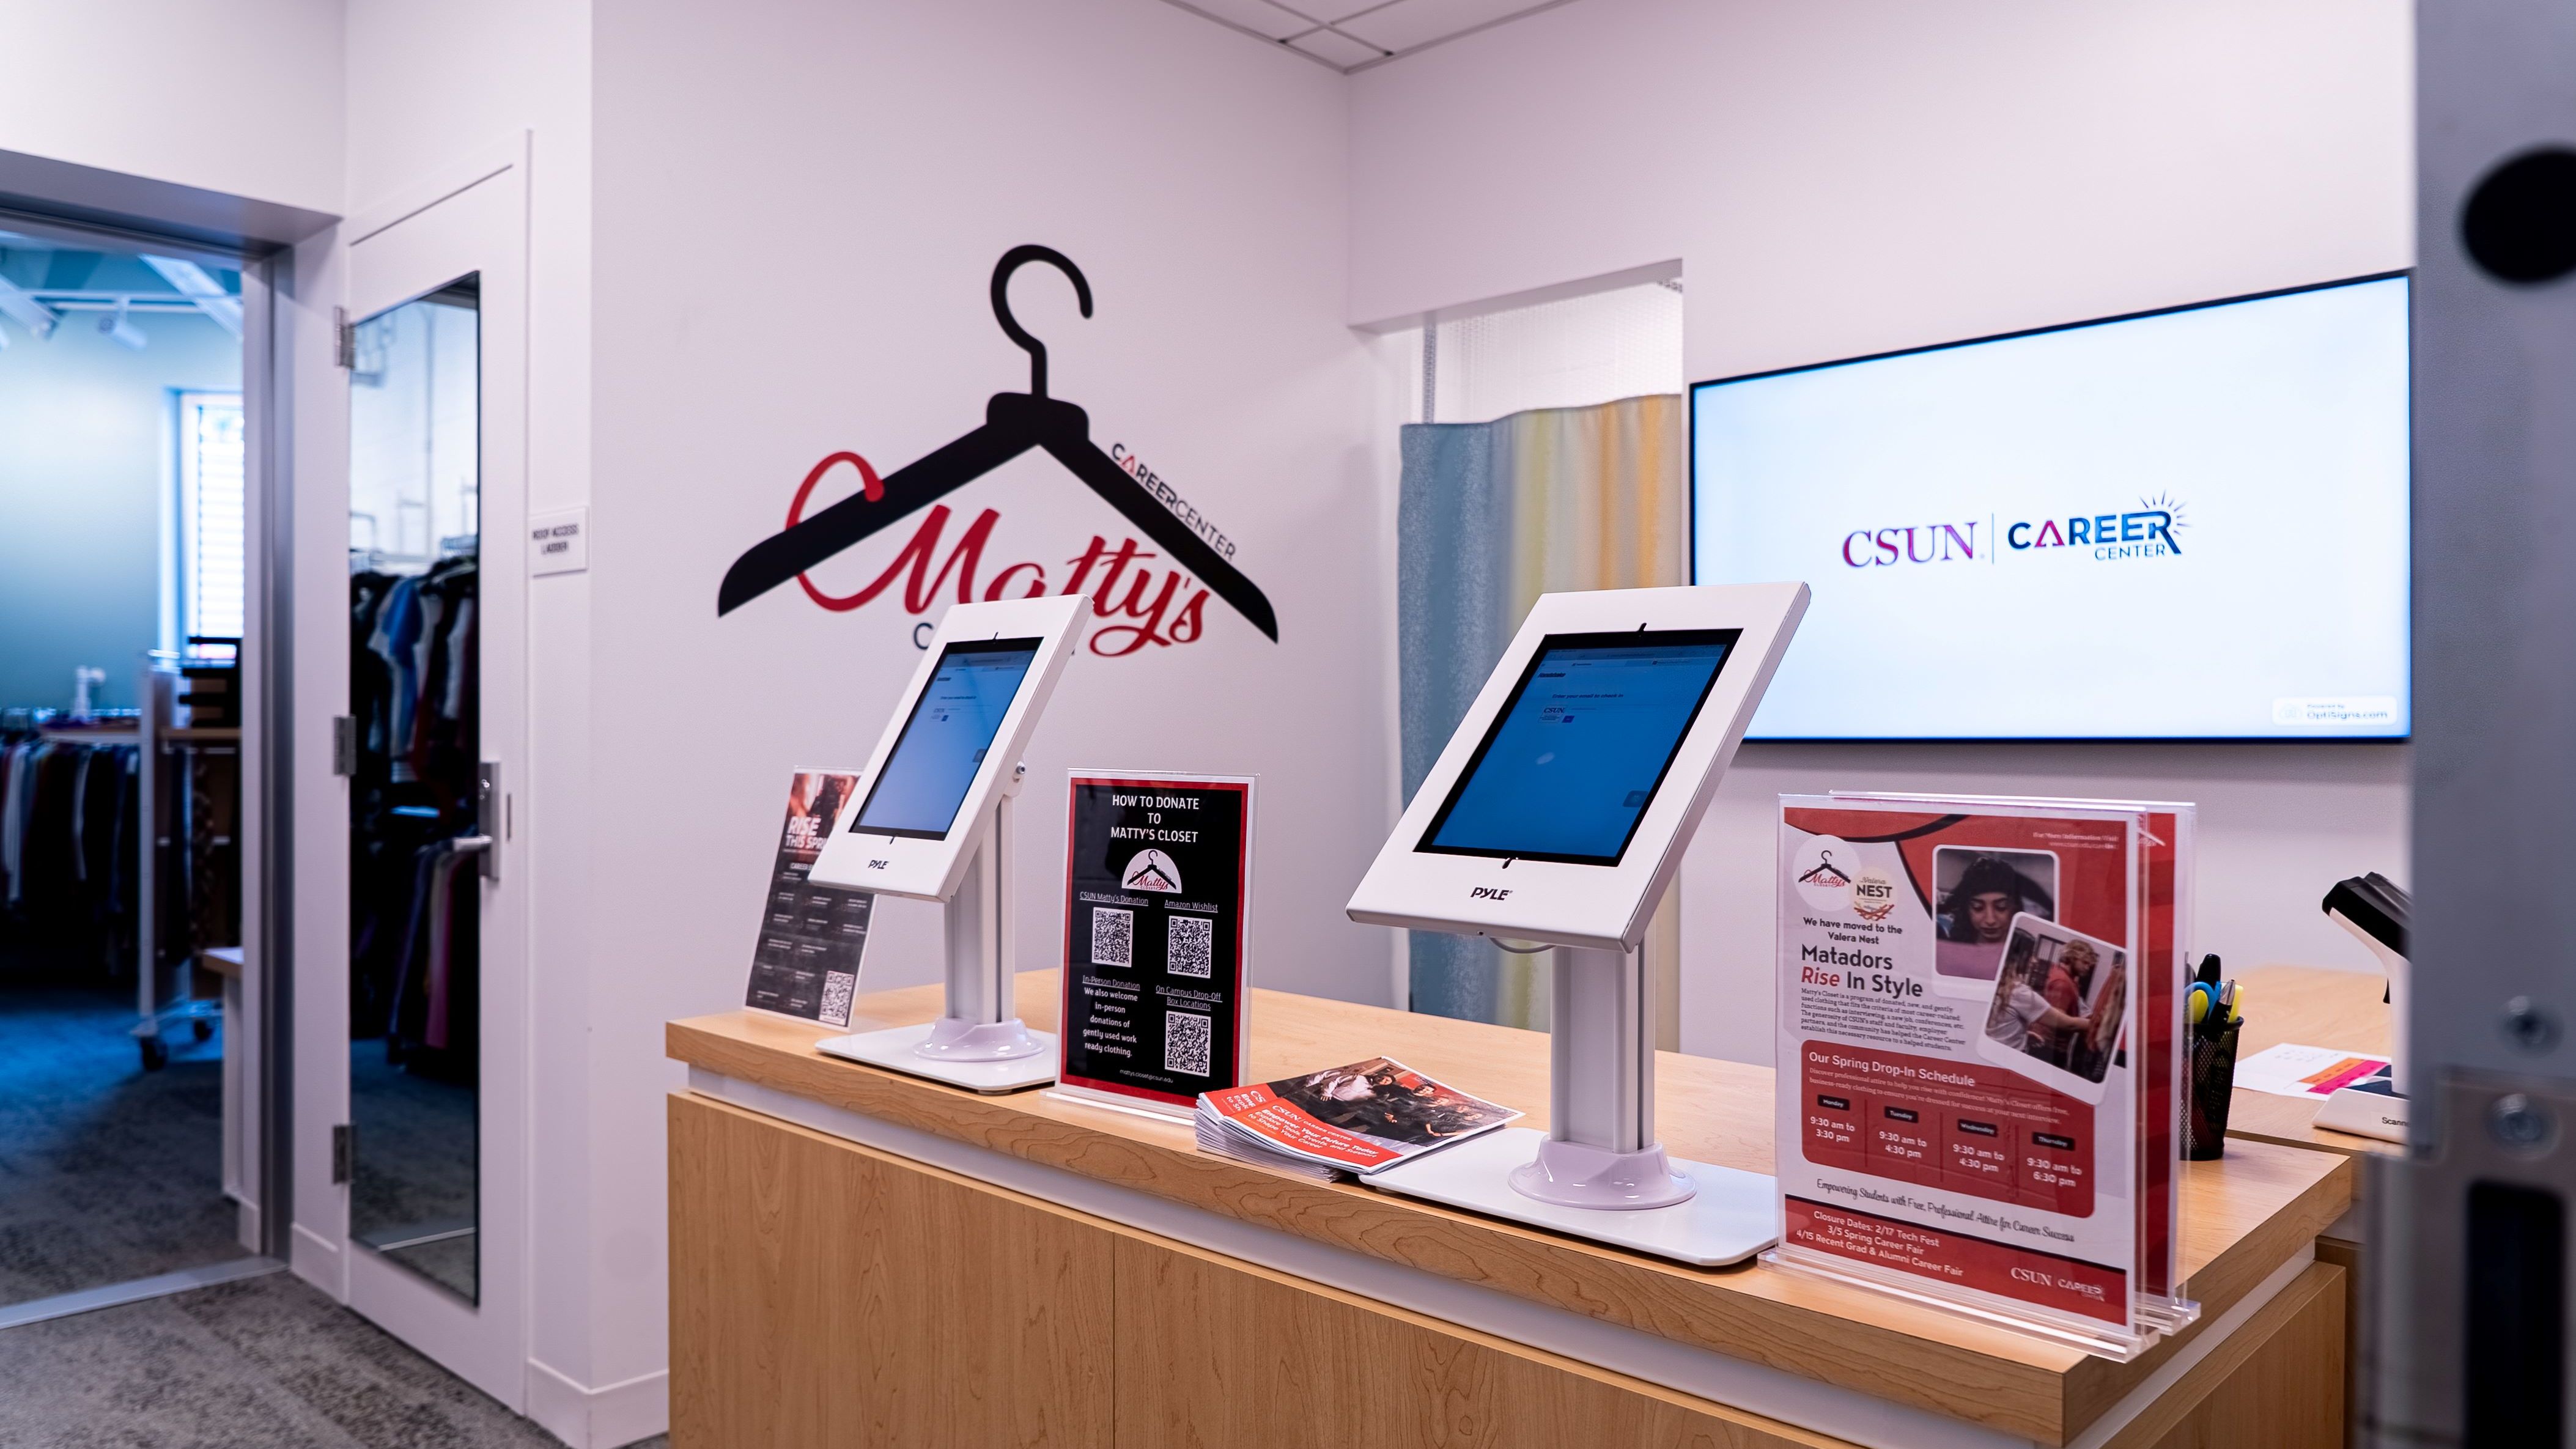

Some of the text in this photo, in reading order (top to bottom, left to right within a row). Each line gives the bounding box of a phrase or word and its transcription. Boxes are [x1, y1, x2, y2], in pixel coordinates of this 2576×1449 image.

[1842, 510, 2181, 569] CSUN CAREER
[785, 451, 1210, 658] Matty's
[2095, 544, 2165, 561] CENTER
[1112, 795, 1199, 809] HOW TO DONATE
[787, 816, 821, 836] RISE
[1147, 813, 1161, 824] TO
[786, 835, 805, 847] THIS
[1111, 827, 1198, 842] MATTY'S CLOSET
[868, 860, 888, 870] PYLE
[1470, 887, 1509, 901] PYLE
[1857, 884, 1892, 898] NEST
[1098, 893, 1119, 903] Matty's
[1121, 895, 1148, 905] Donation
[1164, 899, 1218, 912] Amazon Wishlist
[1803, 917, 1817, 926] We
[1820, 918, 1840, 927] have
[1887, 925, 1902, 934] the
[1828, 932, 1878, 944] Valera Nest
[1802, 945, 1892, 969] Matadors
[1082, 975, 1140, 989] In-Person Donation
[1801, 967, 1922, 998] Rise In Style
[1109, 991, 1137, 1001] welcome
[1165, 986, 1192, 998] Campus
[1194, 990, 1221, 1001] Drop-Off
[1095, 1001, 1125, 1012] in-person
[1179, 998, 1211, 1009] Locations
[1090, 1015, 1121, 1026] donations
[1083, 1029, 1103, 1039] gently
[1085, 1042, 1132, 1057] ready clothing.
[1809, 1052, 1975, 1086] Our Spring Drop-In Schedule
[1272, 1105, 1302, 1121] CSUN
[1810, 1116, 1829, 1126] 9:30
[1846, 1123, 1854, 1131] to
[2382, 1116, 2409, 1127] Scann
[1255, 1111, 1281, 1125] Explore
[1346, 1148, 1377, 1158] Support
[1257, 1118, 1279, 1130] Shape
[1281, 1129, 1297, 1139] Your
[1297, 1138, 1323, 1149] Career
[1261, 1109, 1300, 1129] Empower
[1302, 1127, 1321, 1138] Your
[1321, 1137, 1350, 1148] Future
[1352, 1145, 1379, 1154] Today
[1816, 1129, 1834, 1138] 3:30
[1879, 1131, 1899, 1141] 9:30
[1917, 1138, 1927, 1146] to
[1885, 1145, 1905, 1154] 4:30
[1953, 1144, 1974, 1154] 9:30
[1993, 1151, 2004, 1160] to
[1959, 1158, 1980, 1168] 4:30
[2027, 1157, 2051, 1168] 9:30
[2070, 1165, 2082, 1174] to
[2033, 1171, 2056, 1182] 6:30
[1817, 1179, 1858, 1200] Empowering
[1859, 1188, 1889, 1202] Students
[1891, 1195, 1906, 1206] with
[1927, 1202, 1974, 1220] Professional
[1814, 1211, 1939, 1247] Closure Dates: 2/17 Tech Fest
[1827, 1225, 1924, 1254] 3/5 Spring Career Fair
[1796, 1230, 1963, 1275] 4/15 Recent Grad & Alumni Career Fair
[2010, 1267, 2052, 1286] CSUN
